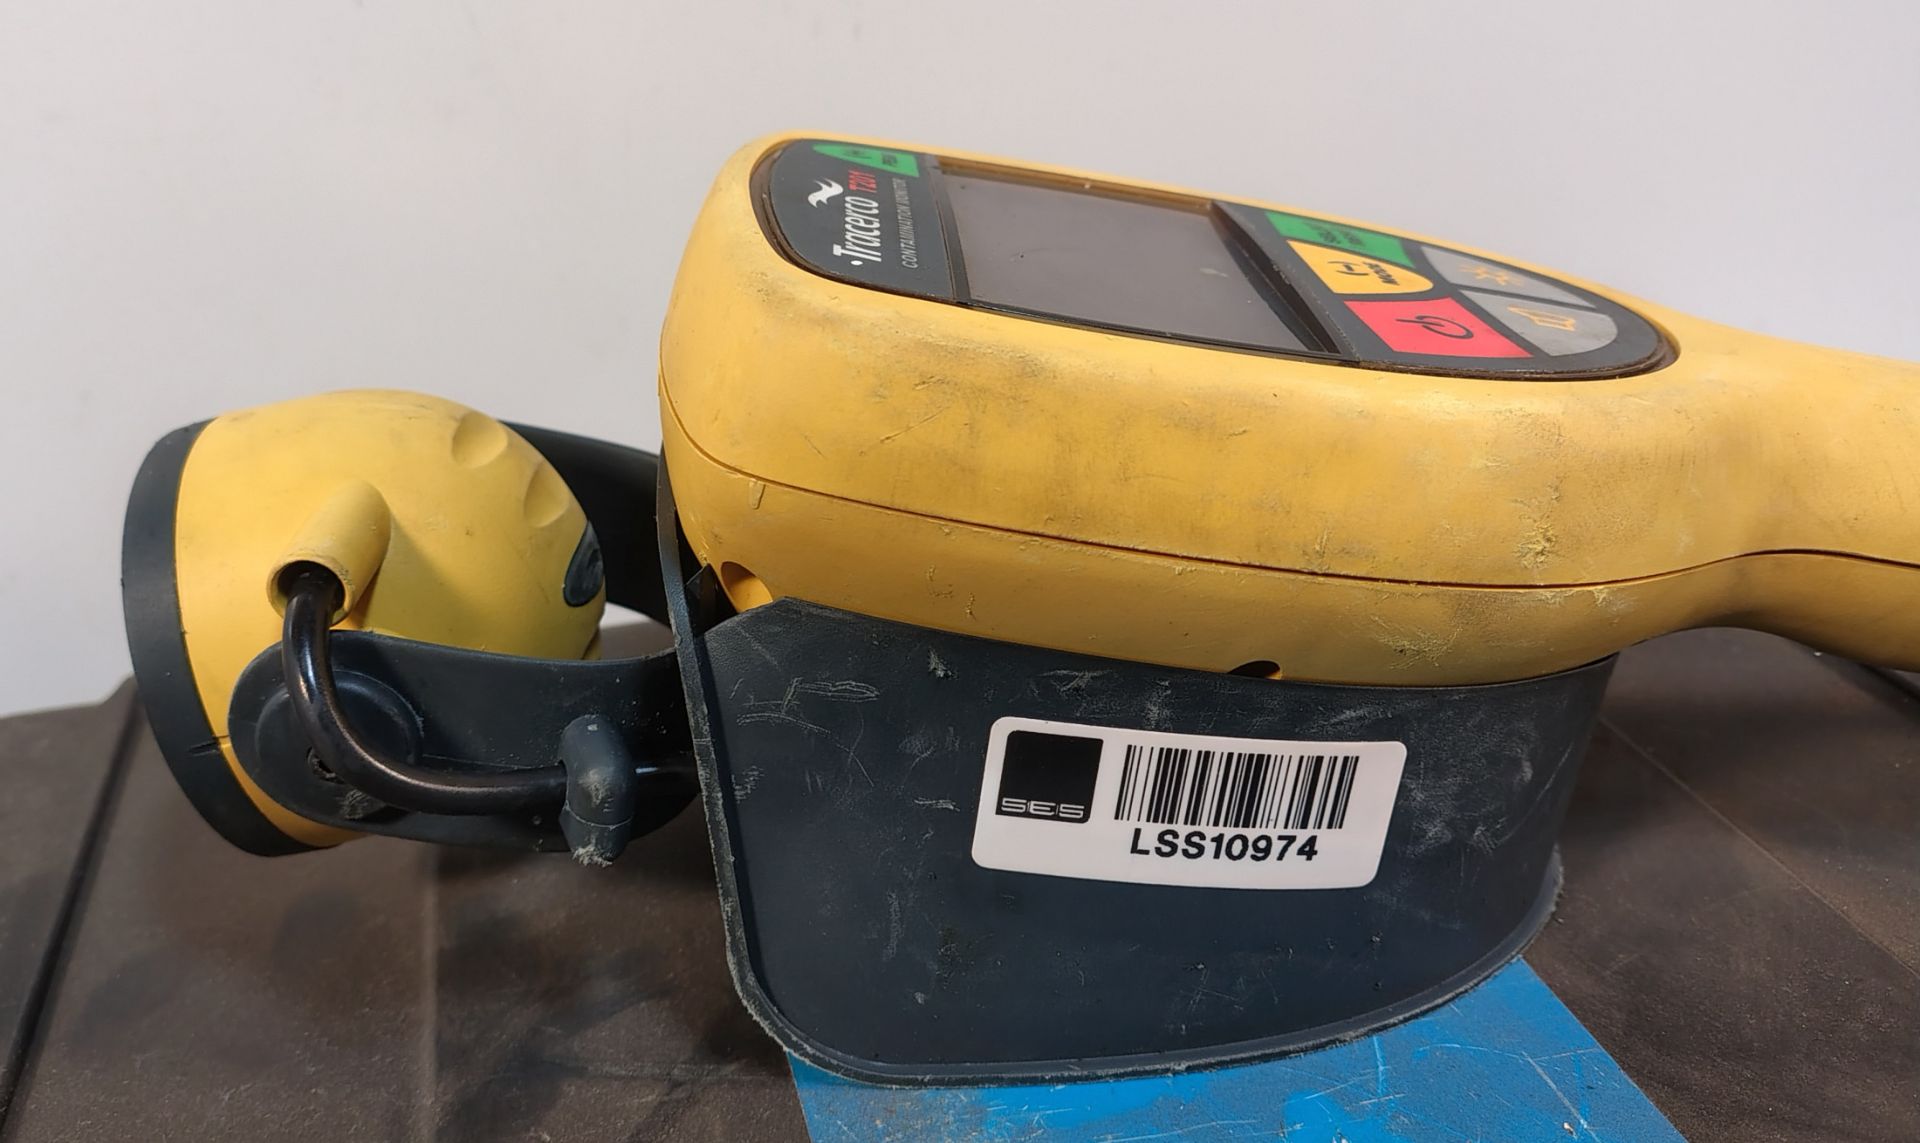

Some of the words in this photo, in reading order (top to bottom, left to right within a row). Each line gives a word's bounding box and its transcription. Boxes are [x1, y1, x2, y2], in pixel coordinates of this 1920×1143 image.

[832, 196, 882, 262] Tracerco
[896, 205, 918, 269] CONTAMINATION
[1001, 797, 1085, 819] SES
[1129, 828, 1319, 862] LSS10974
